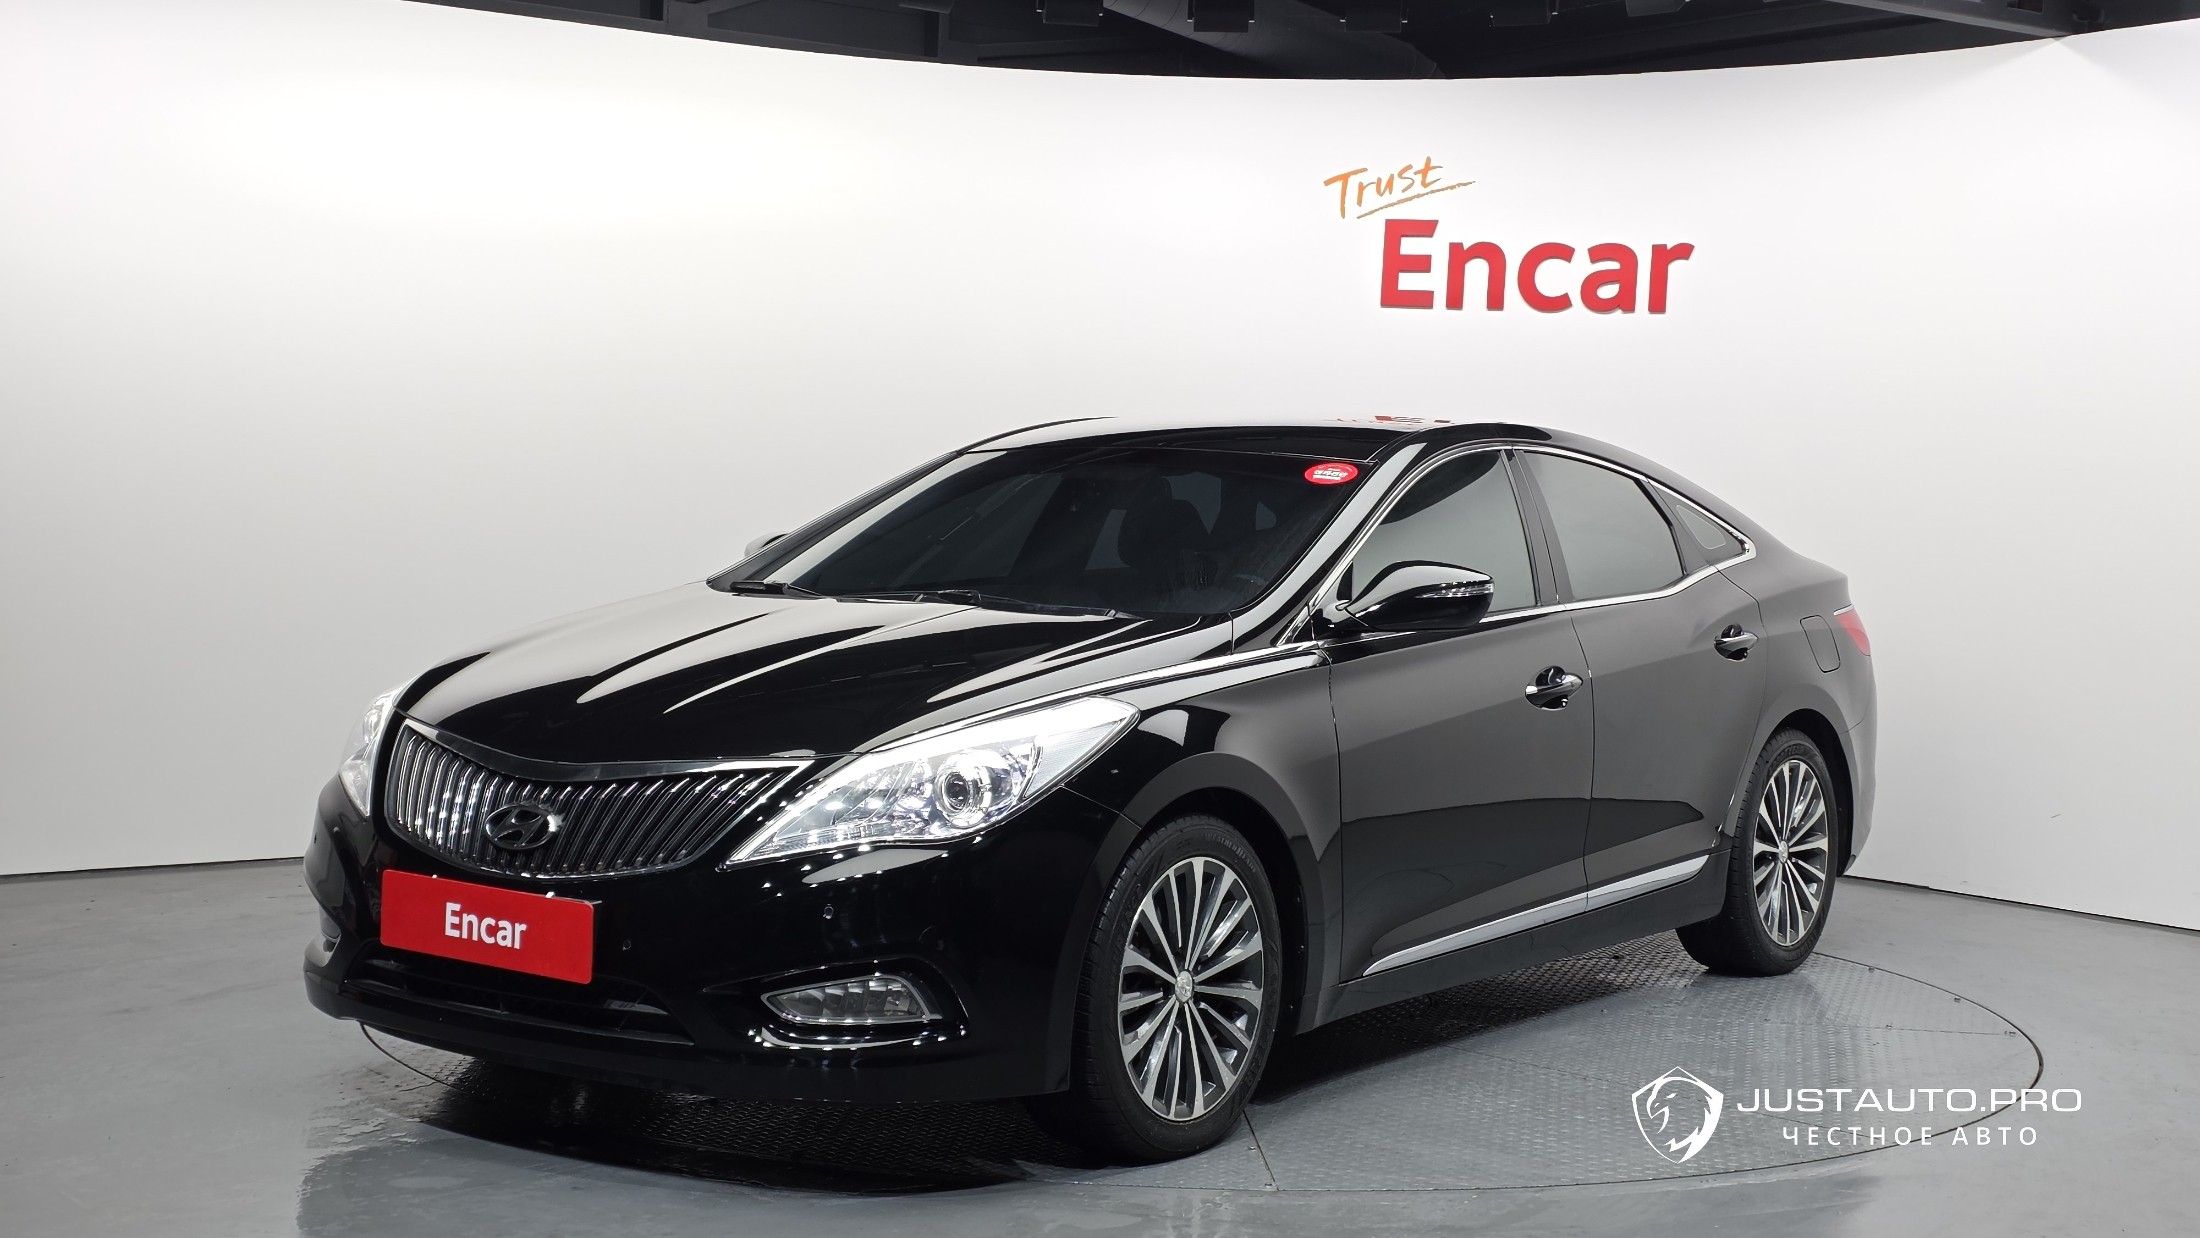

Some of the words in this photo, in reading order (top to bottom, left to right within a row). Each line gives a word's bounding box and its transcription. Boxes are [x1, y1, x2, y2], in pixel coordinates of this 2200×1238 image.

[1323, 156, 1443, 218] Trust
[1380, 219, 1695, 314] Encar
[444, 901, 527, 950] Encar
